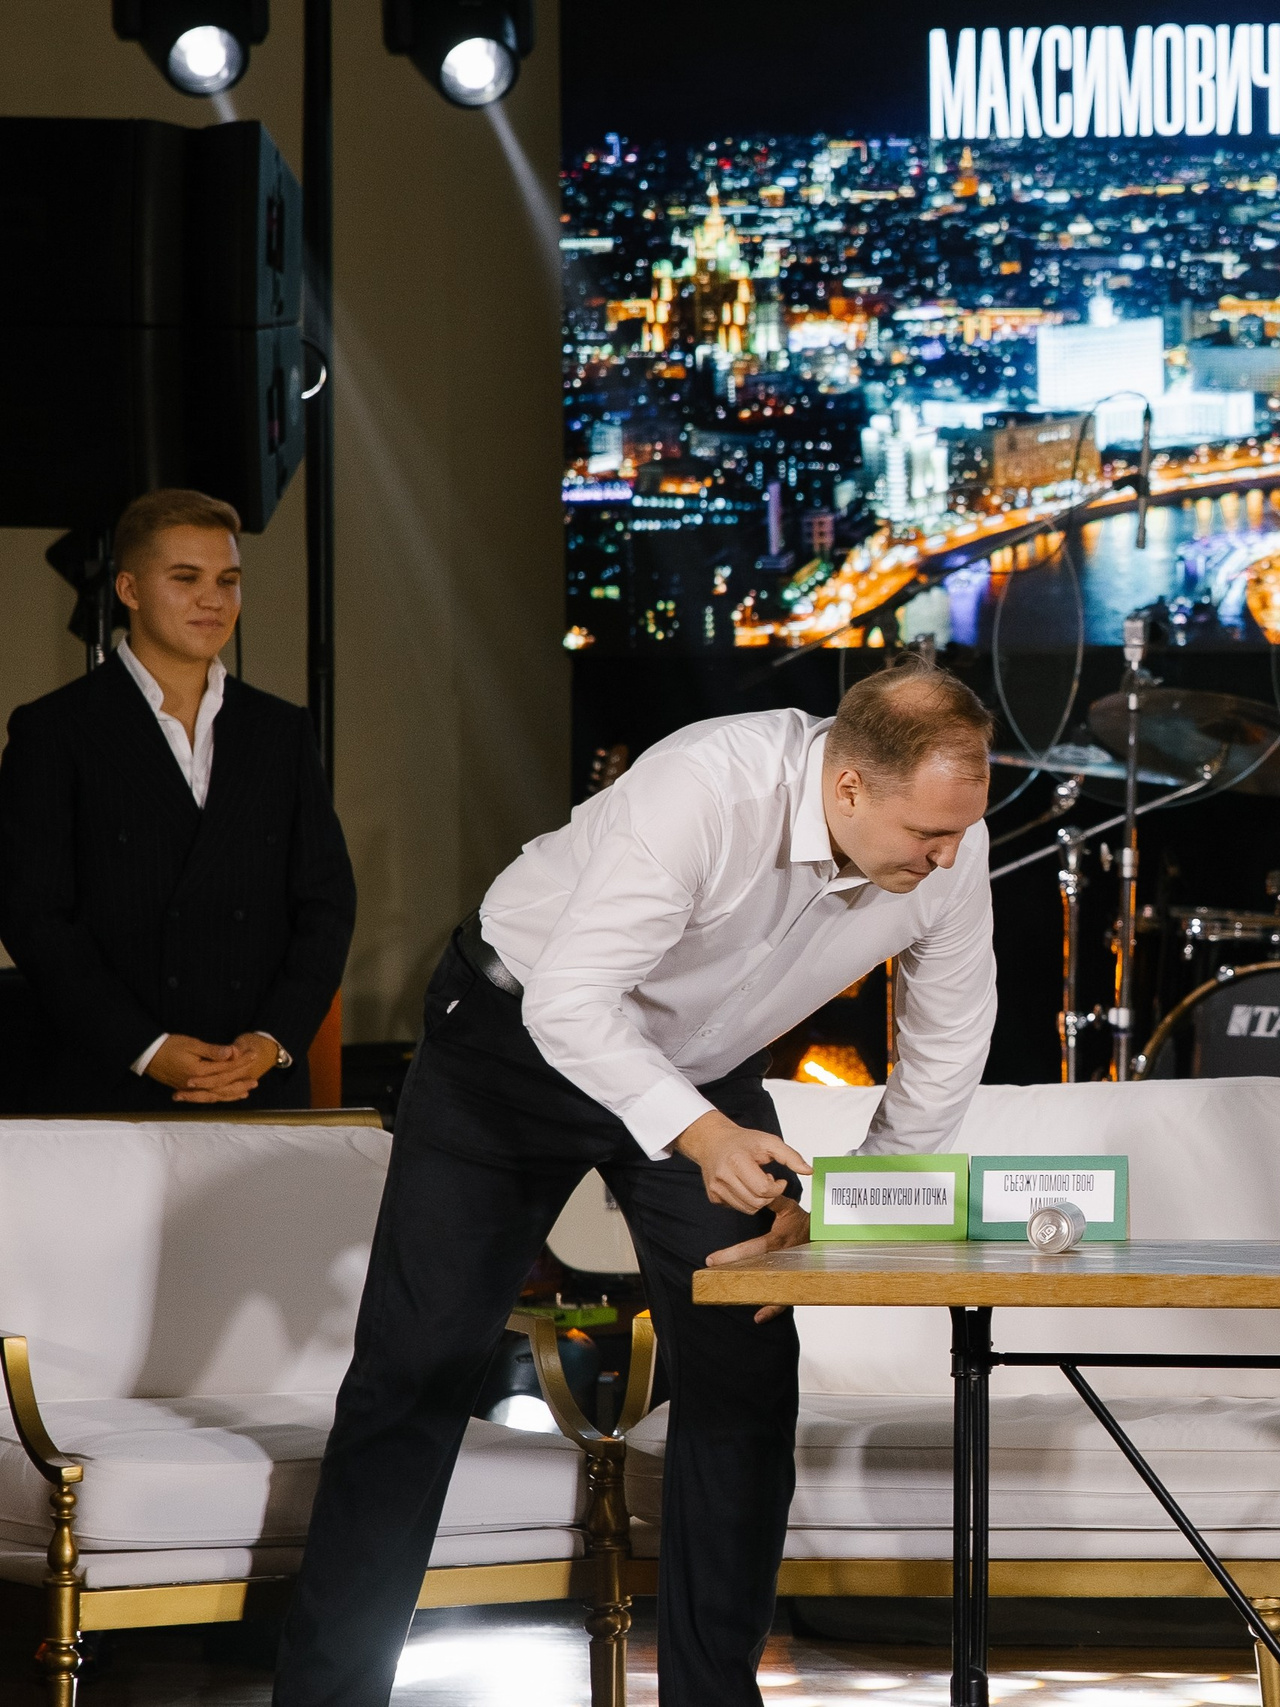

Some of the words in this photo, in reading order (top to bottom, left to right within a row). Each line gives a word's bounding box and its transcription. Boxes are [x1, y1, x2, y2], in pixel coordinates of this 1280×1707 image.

[1004, 1174, 1037, 1192] СЪЕЗЖУ
[1039, 1174, 1070, 1192] ПОМОЮ
[1072, 1174, 1095, 1192] ТВОЮ
[831, 1187, 868, 1208] ПОЕЗДКА
[870, 1187, 880, 1206] ВО
[882, 1187, 913, 1206] ВКУСНО
[914, 1187, 920, 1206] И
[922, 1187, 948, 1206] ТОЧКА
